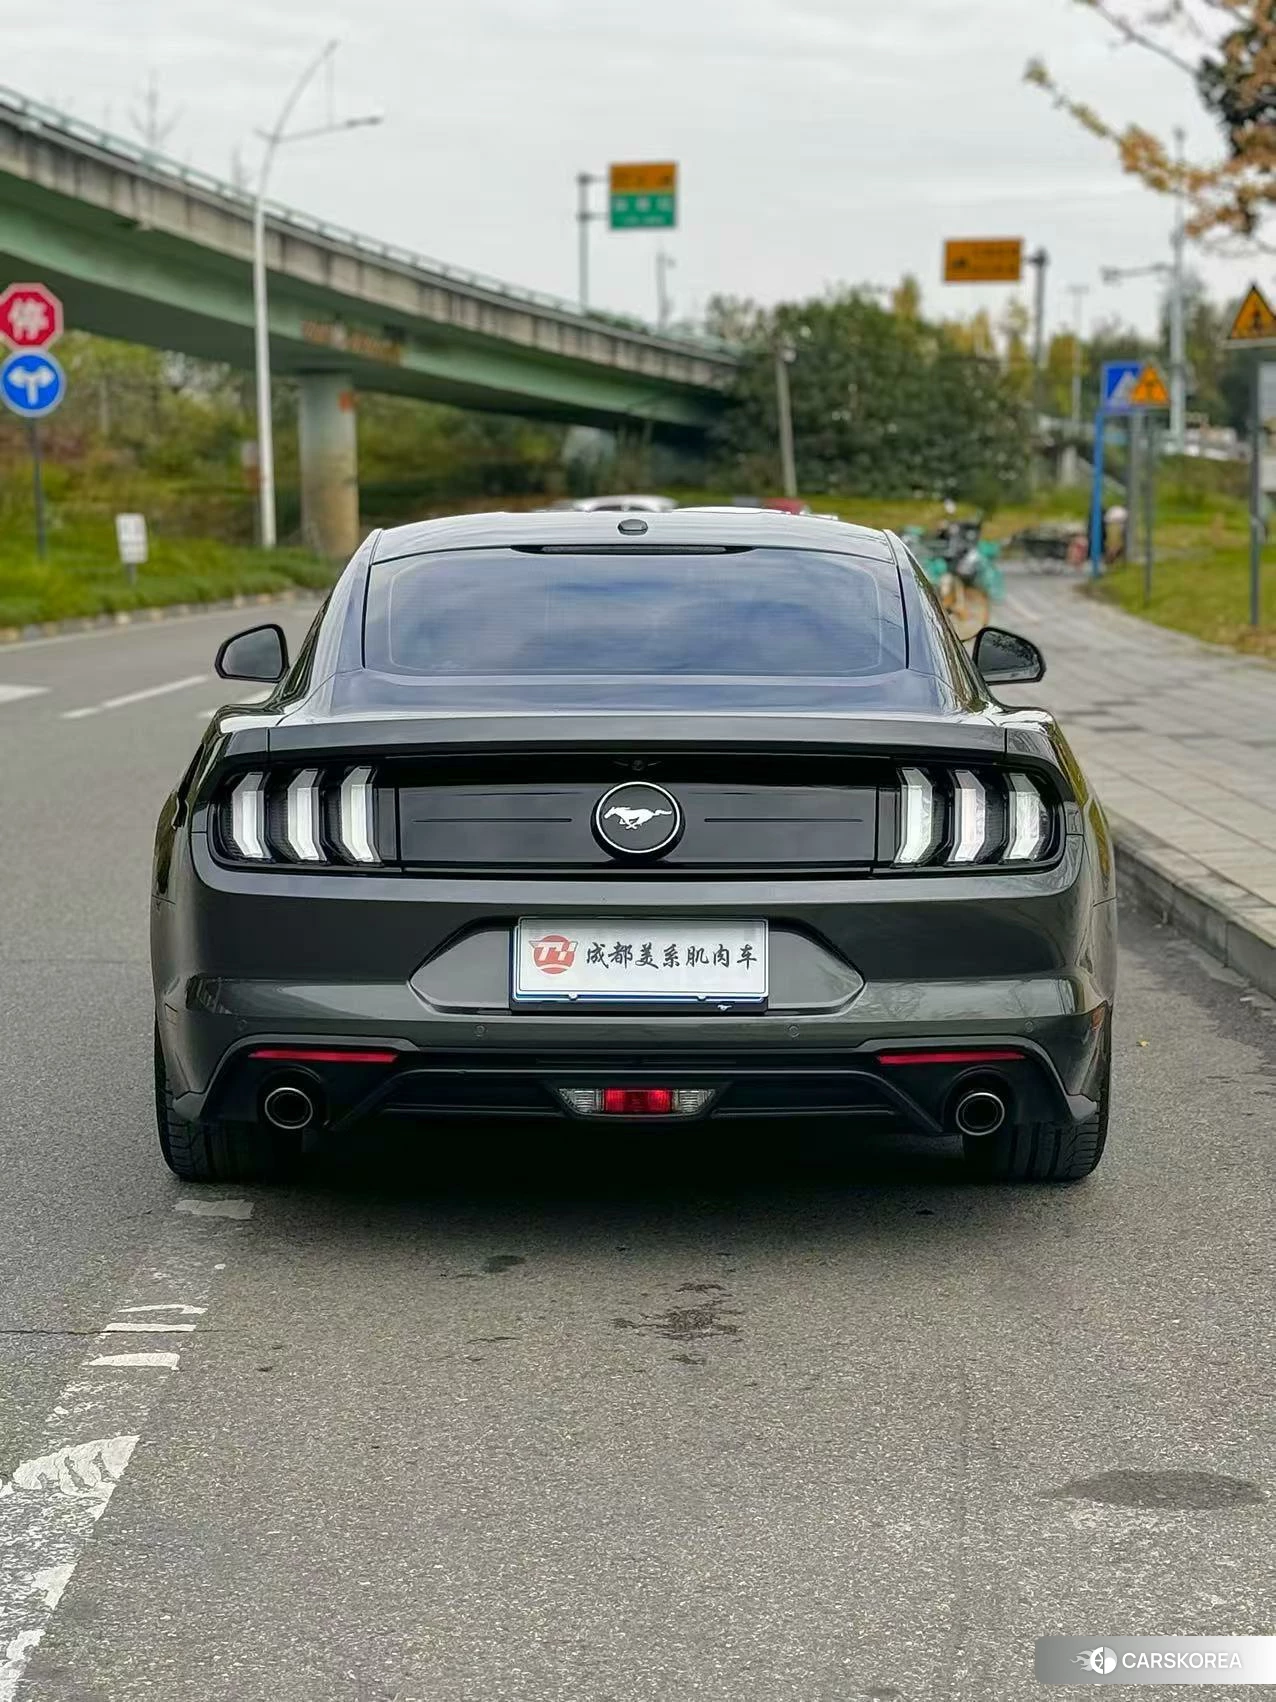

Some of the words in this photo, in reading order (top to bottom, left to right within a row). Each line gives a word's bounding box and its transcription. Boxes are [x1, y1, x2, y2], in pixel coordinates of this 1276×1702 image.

[586, 941, 758, 970] 成都美系肌肉车
